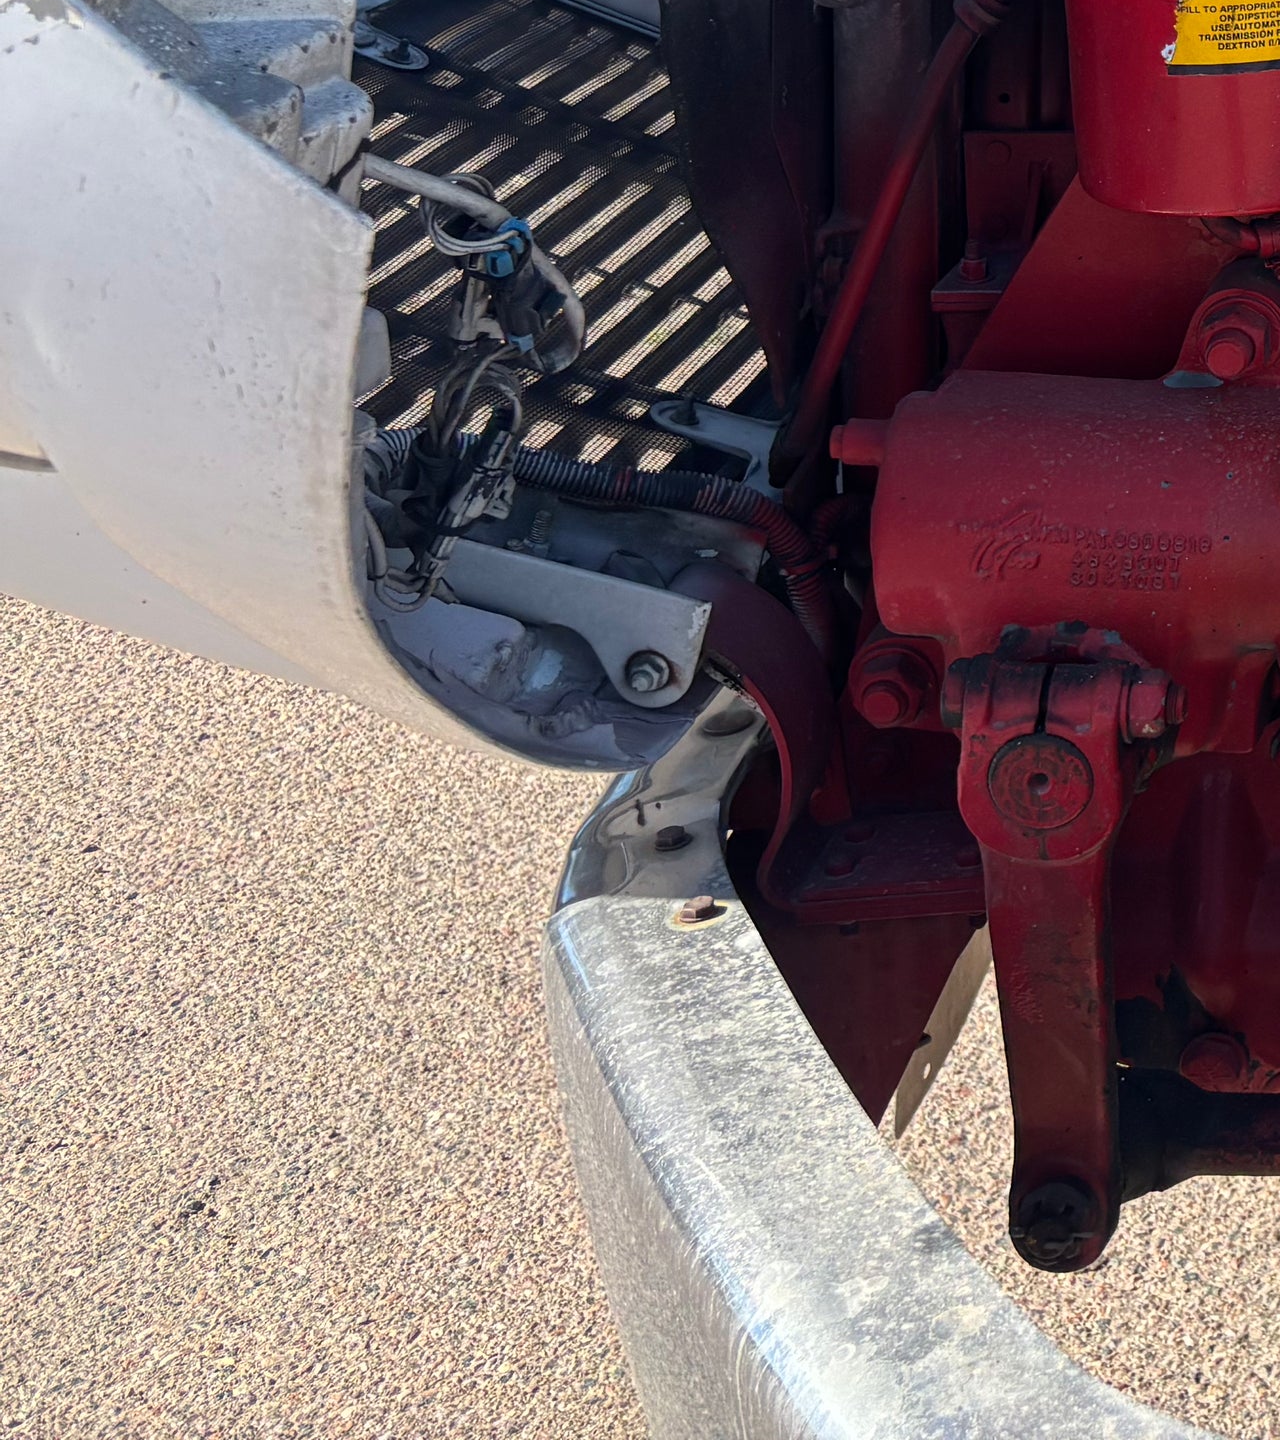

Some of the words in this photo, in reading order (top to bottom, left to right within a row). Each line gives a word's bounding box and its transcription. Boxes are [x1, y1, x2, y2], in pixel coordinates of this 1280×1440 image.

[1203, 5, 1217, 13] TO
[1219, 14, 1234, 22] ON
[1211, 24, 1231, 32] USE
[1198, 30, 1274, 42] TRANSMISSION
[1218, 40, 1266, 51] DEXTRON
